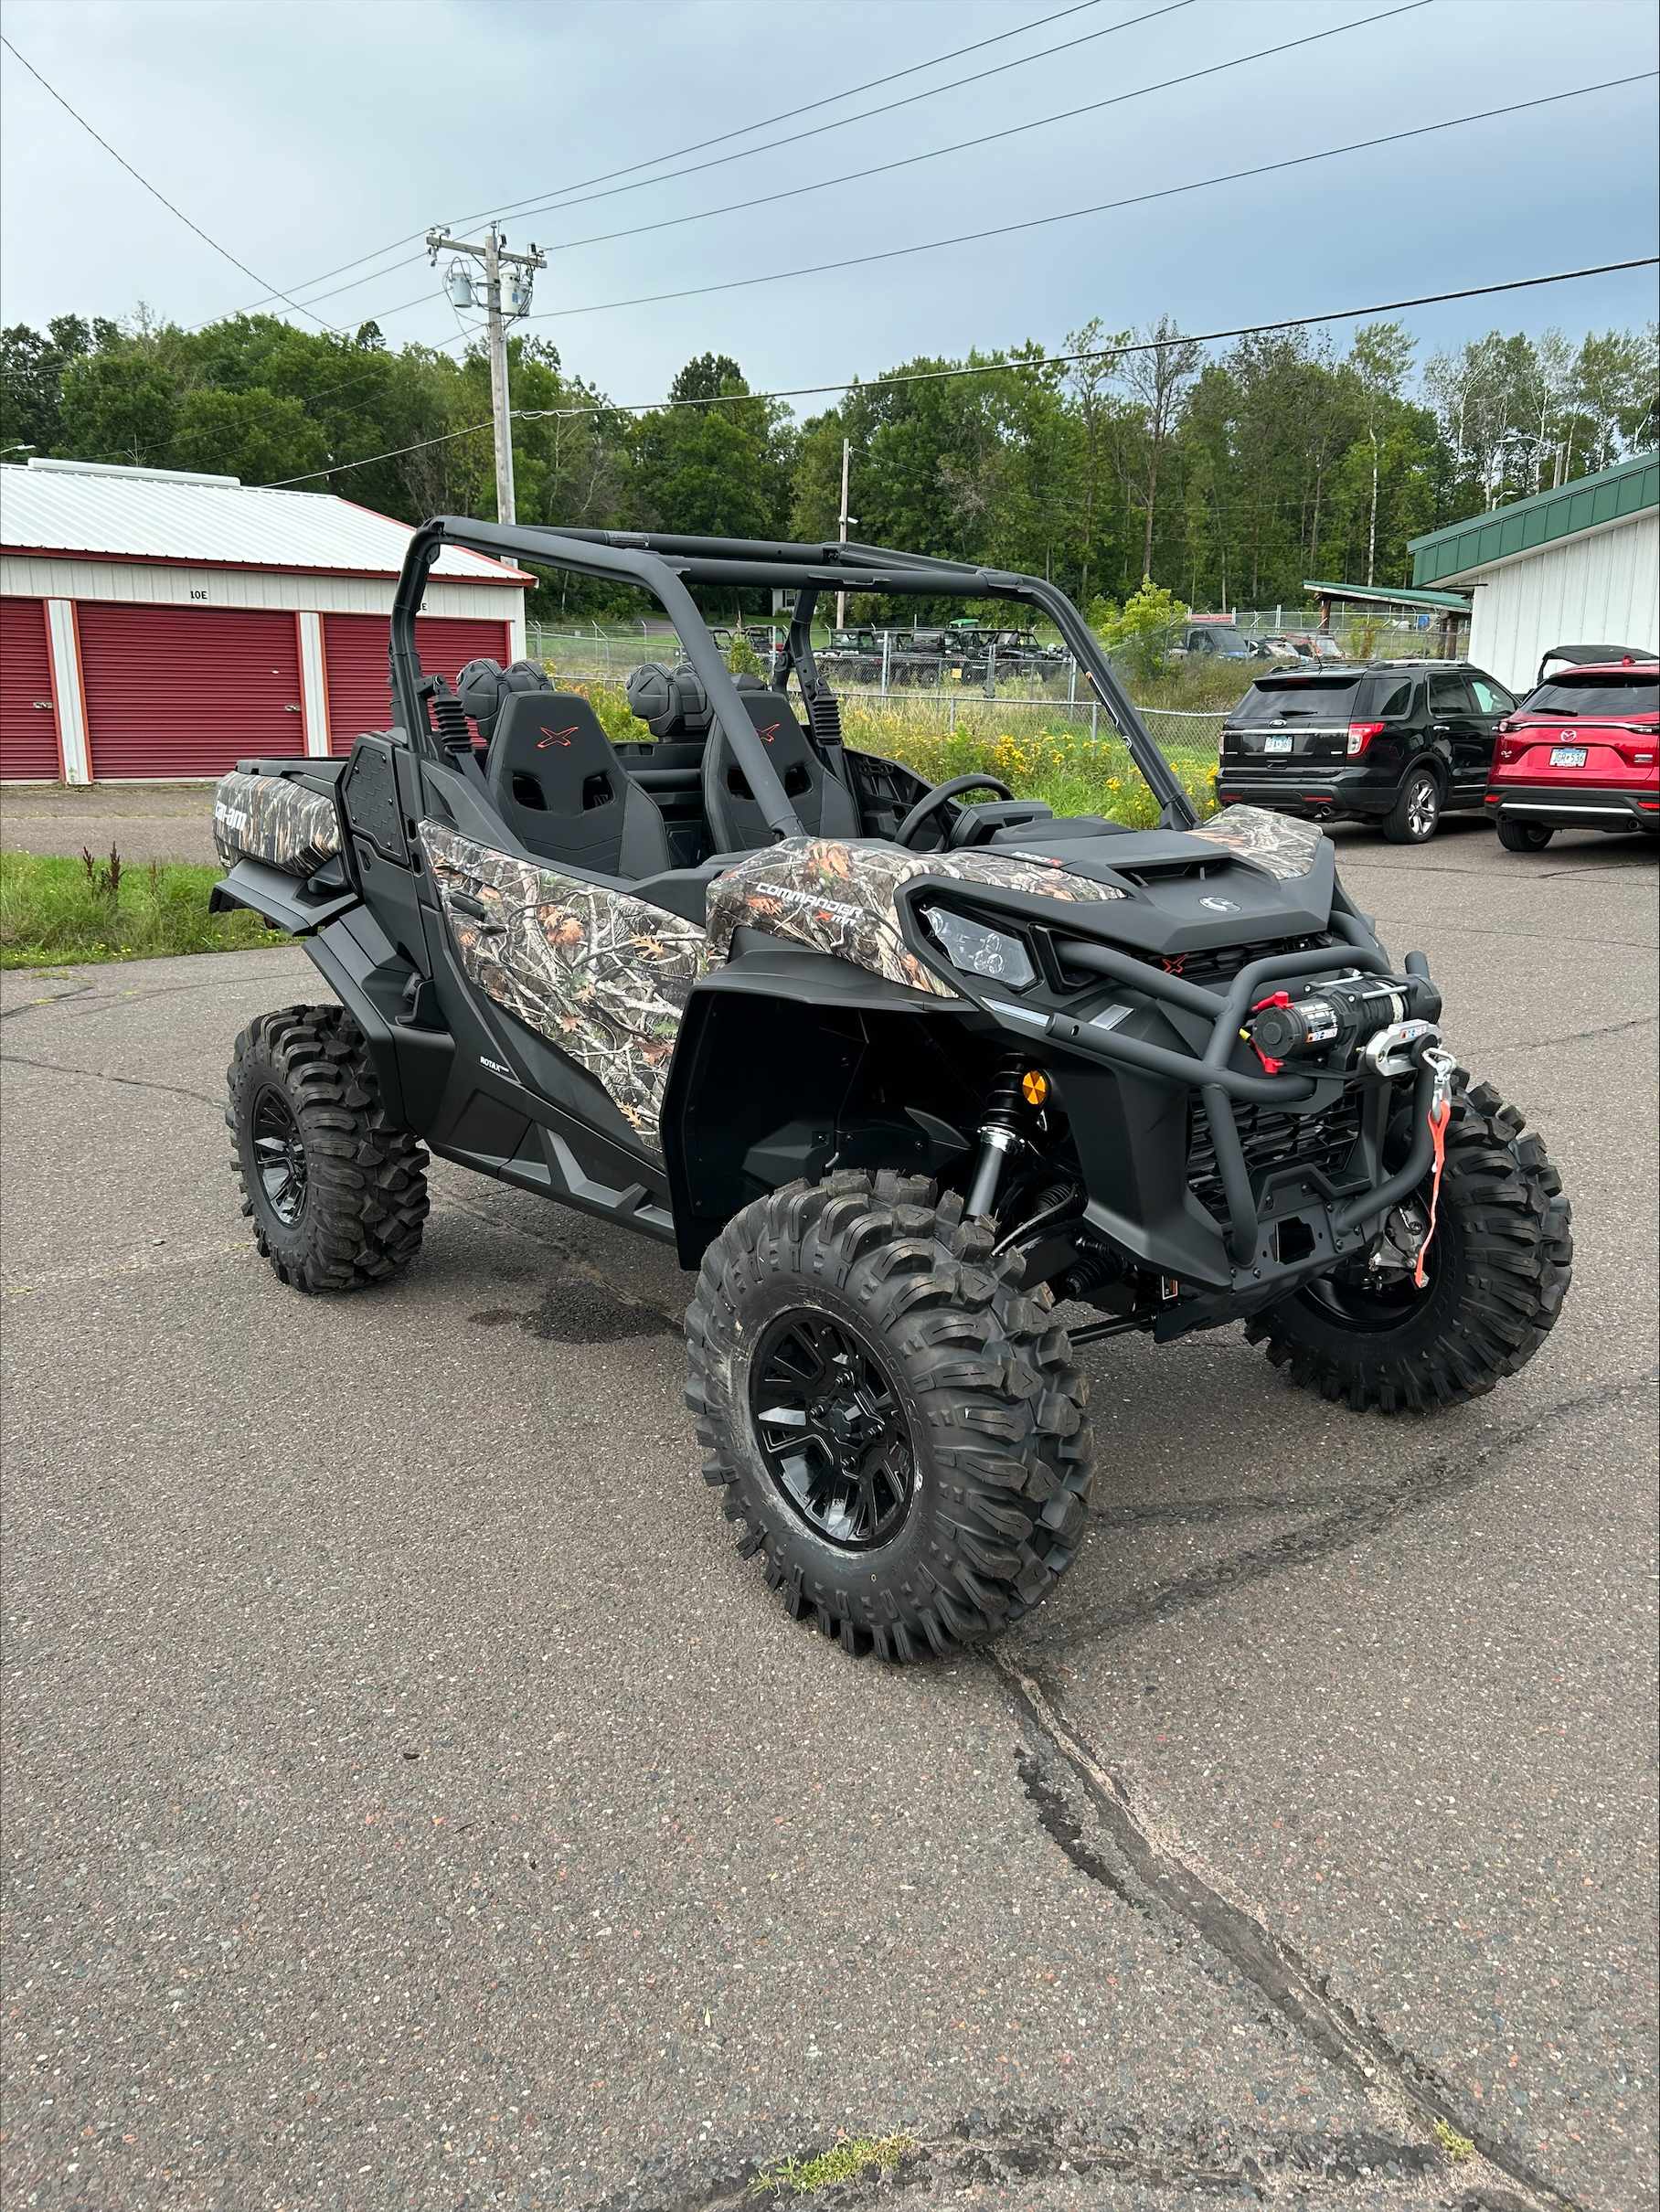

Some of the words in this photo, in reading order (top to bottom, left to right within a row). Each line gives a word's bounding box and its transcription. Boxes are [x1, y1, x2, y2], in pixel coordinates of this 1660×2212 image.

[190, 590, 208, 600] 10E
[756, 882, 863, 918] COMMANDER
[480, 1055, 501, 1072] ROTAX
